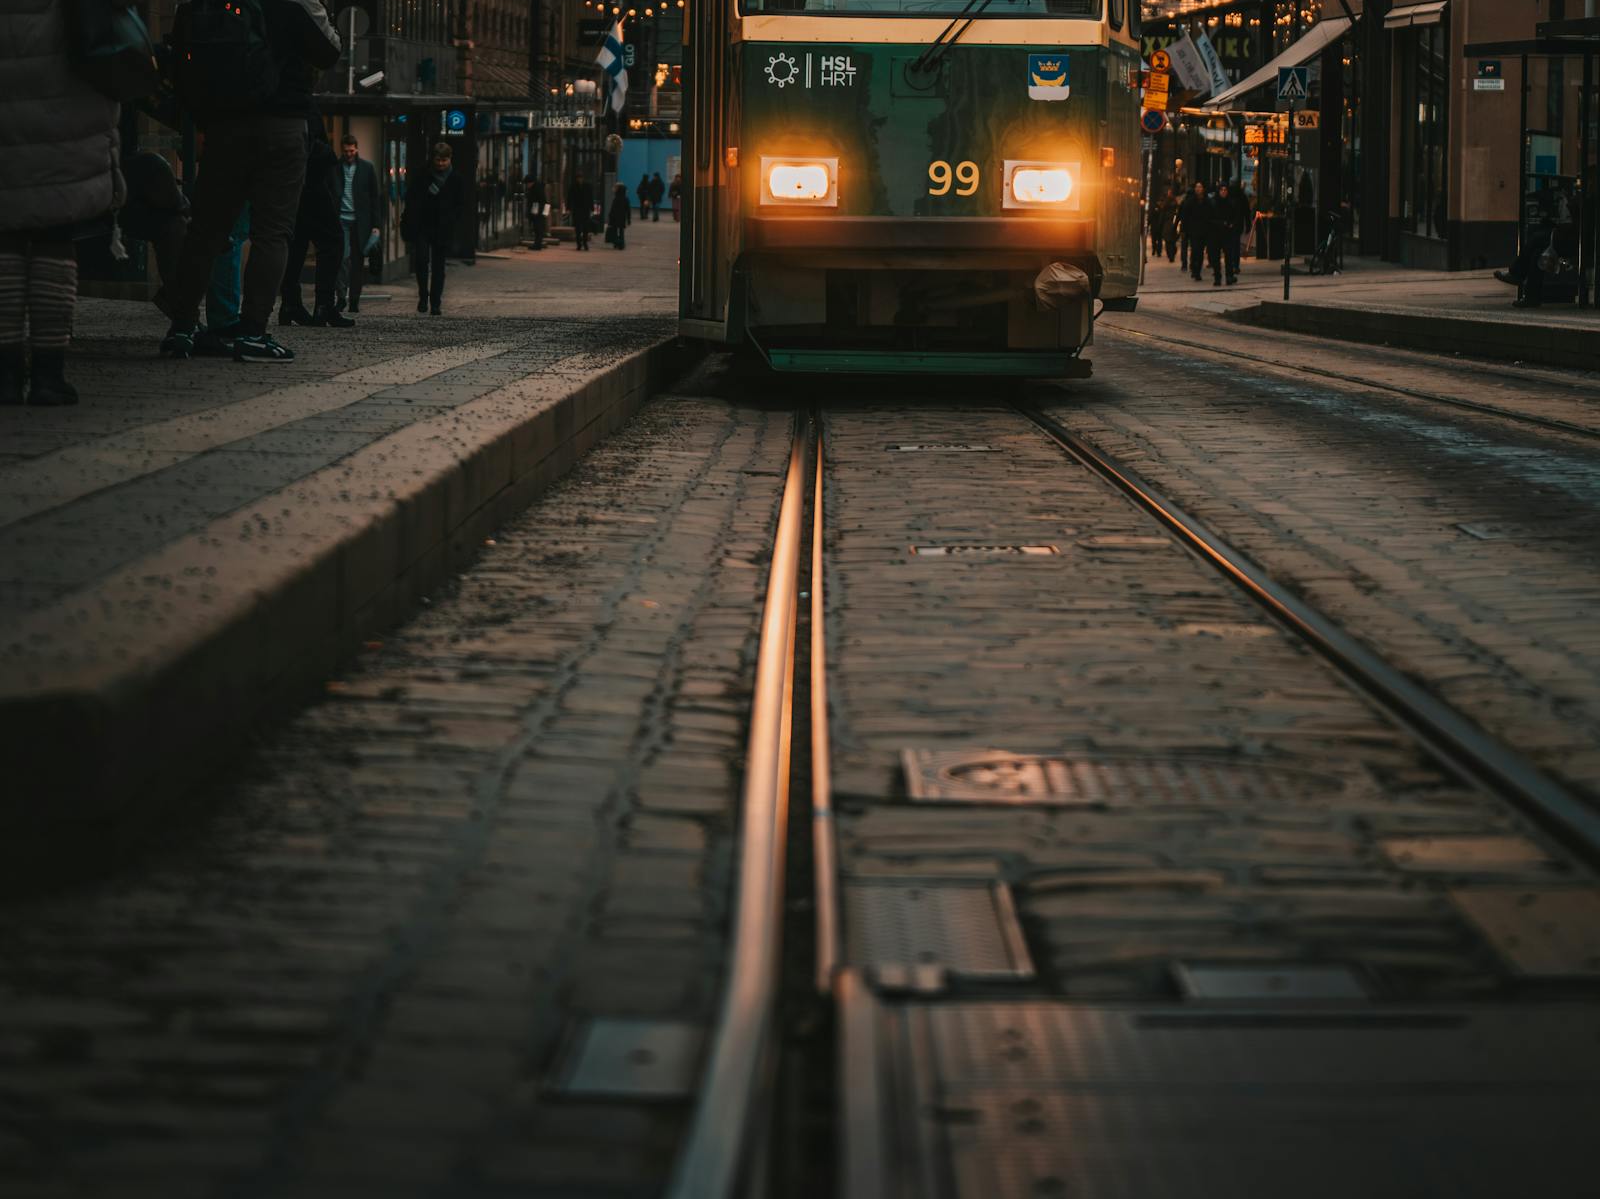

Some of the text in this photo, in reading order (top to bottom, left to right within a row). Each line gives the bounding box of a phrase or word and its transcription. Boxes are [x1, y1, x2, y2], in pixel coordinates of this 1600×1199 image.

[624, 44, 635, 66] GLO
[821, 56, 857, 71] HSL
[821, 71, 857, 87] HRT
[1298, 115, 1315, 127] 9A
[928, 160, 980, 197] 99
